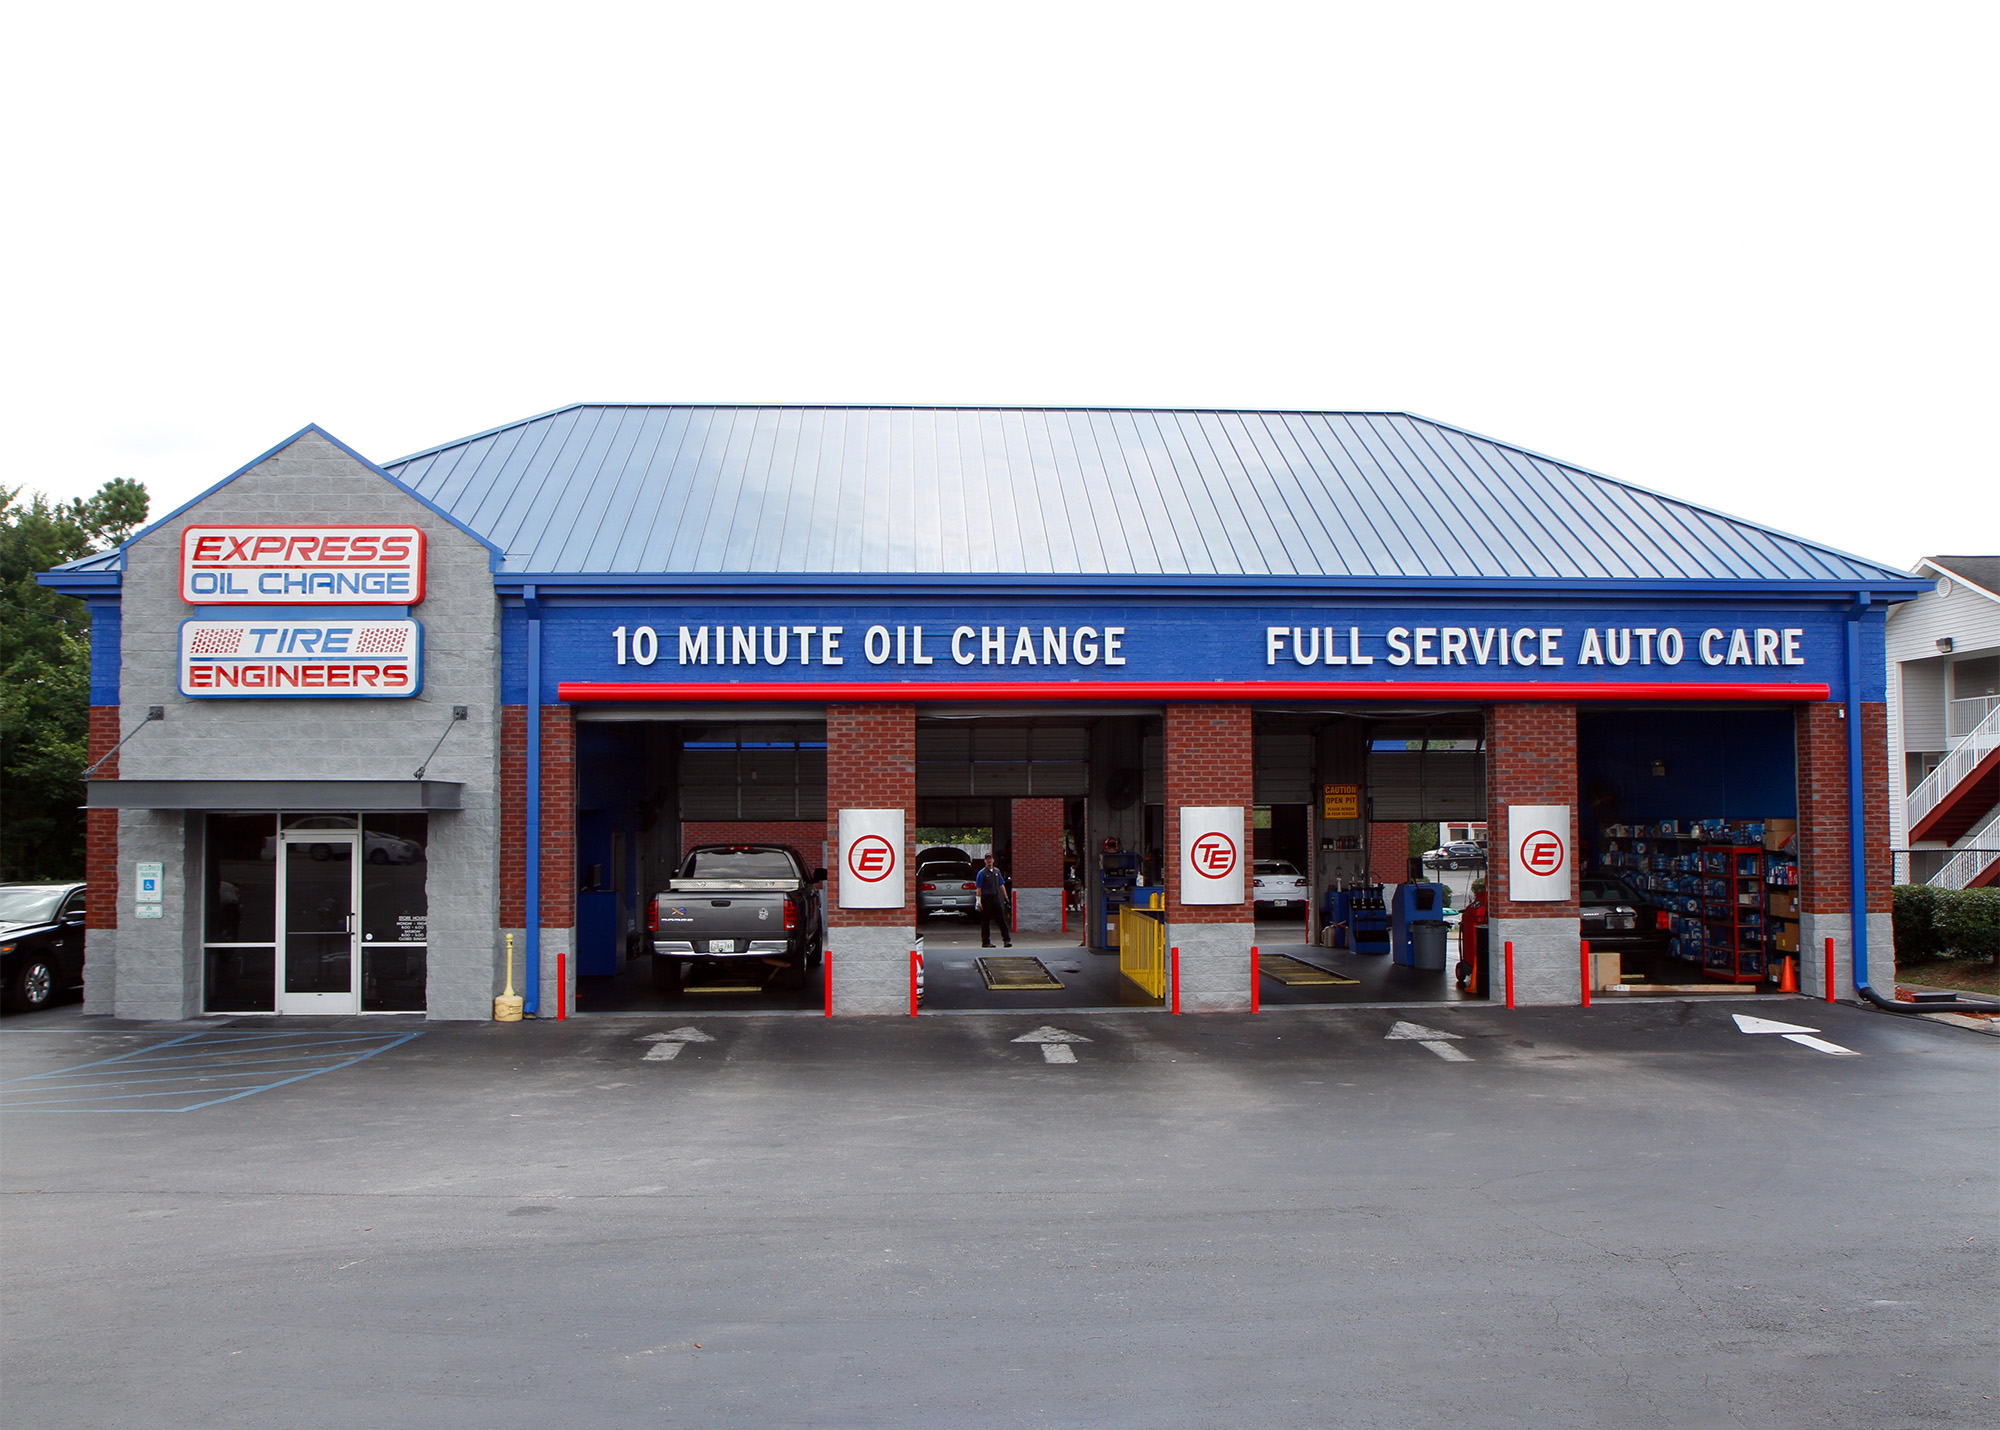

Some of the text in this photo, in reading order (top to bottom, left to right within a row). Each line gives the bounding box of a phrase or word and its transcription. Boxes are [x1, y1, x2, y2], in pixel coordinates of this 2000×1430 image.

[192, 536, 413, 561] EXPRESS
[191, 572, 410, 595] OIL CHANGE
[249, 628, 353, 654] TIRE
[613, 625, 1126, 666] 10 MINUTE OIL CHANGE
[1267, 626, 1805, 666] FULL SERVICE AUTO CARE
[189, 665, 409, 688] ENGINEERS
[1325, 786, 1356, 794] CAUTION
[858, 848, 888, 871] E
[1198, 844, 1231, 869] TE
[1531, 843, 1557, 865] E
